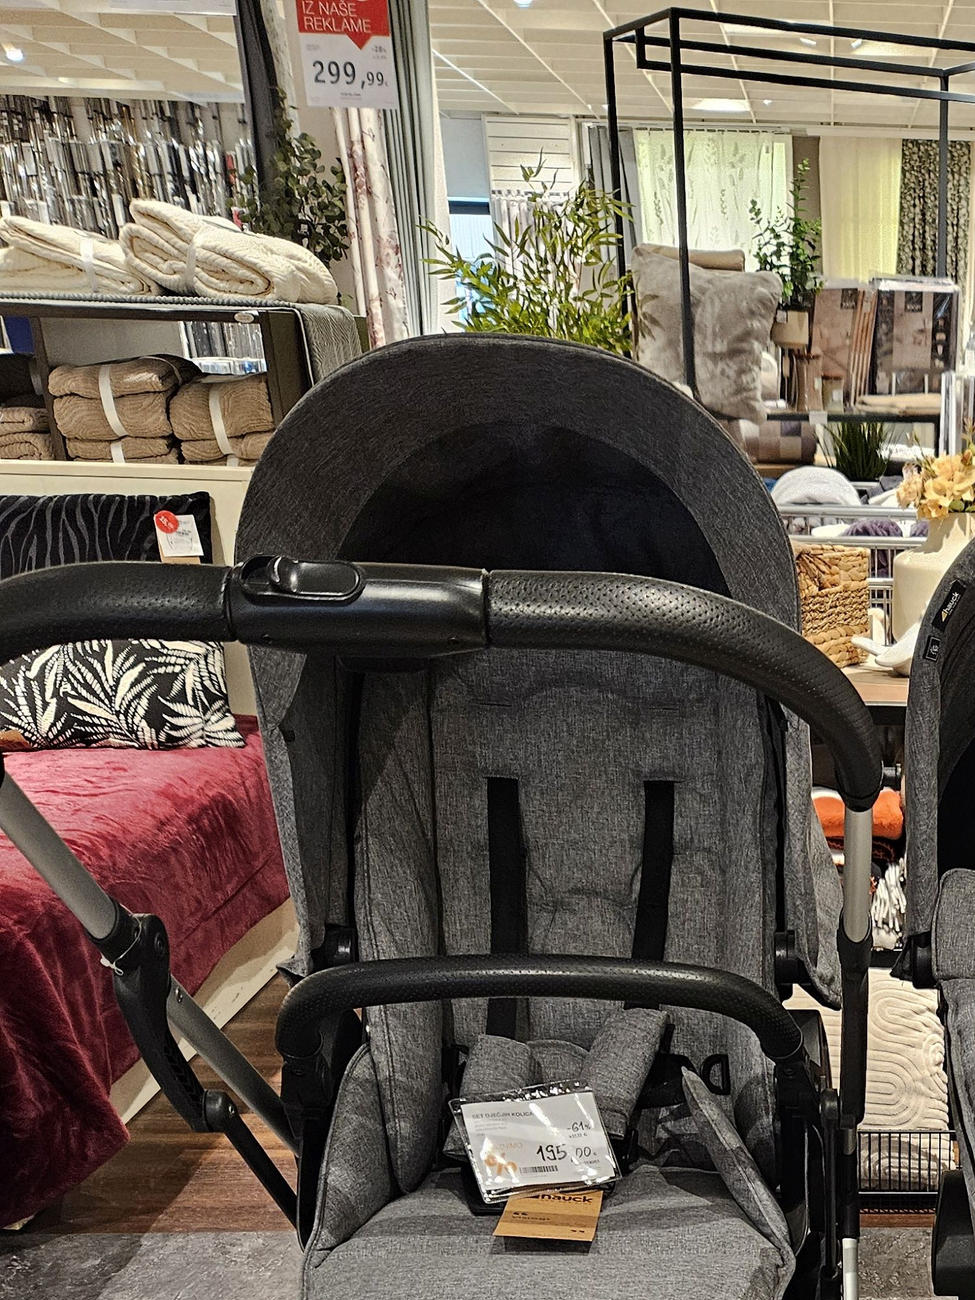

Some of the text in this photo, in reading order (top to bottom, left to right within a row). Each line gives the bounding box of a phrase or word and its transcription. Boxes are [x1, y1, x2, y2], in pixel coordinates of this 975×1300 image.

[302, 1, 357, 17] IZ NAŠE
[303, 16, 372, 34] REKLAME
[942, 591, 960, 614] hauck
